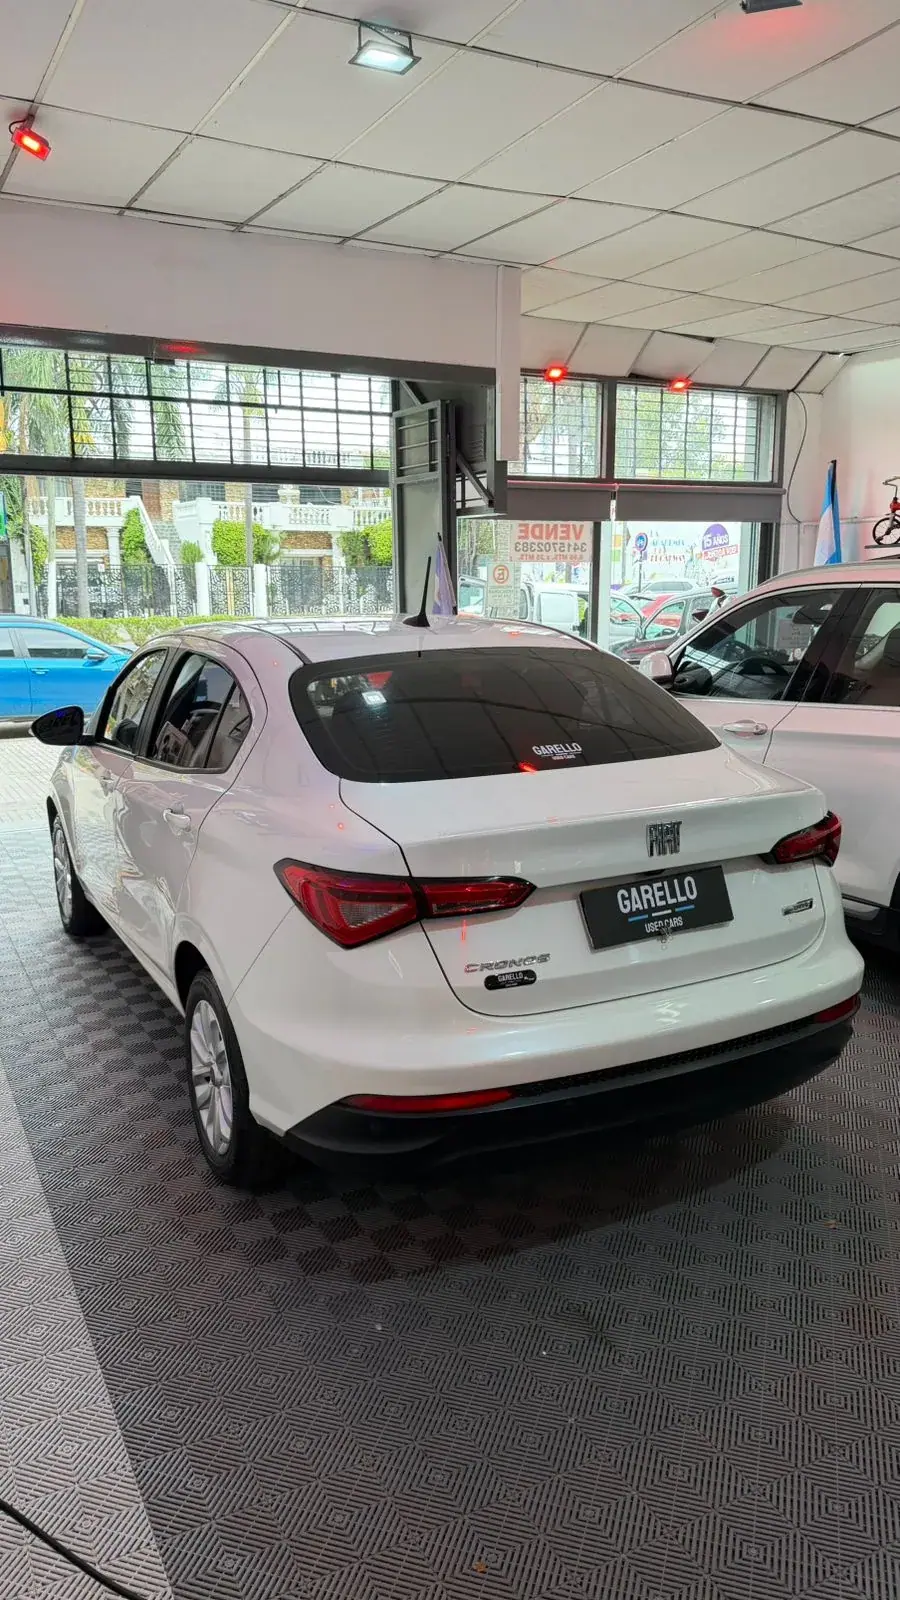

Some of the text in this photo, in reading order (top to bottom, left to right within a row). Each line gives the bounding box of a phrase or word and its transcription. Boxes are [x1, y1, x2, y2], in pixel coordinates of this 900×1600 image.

[532, 742, 582, 755] GARELLO
[646, 821, 682, 857] FIAT
[617, 876, 698, 914] GARELLO
[464, 953, 551, 974] CRONOS
[497, 972, 524, 982] GARELLO
